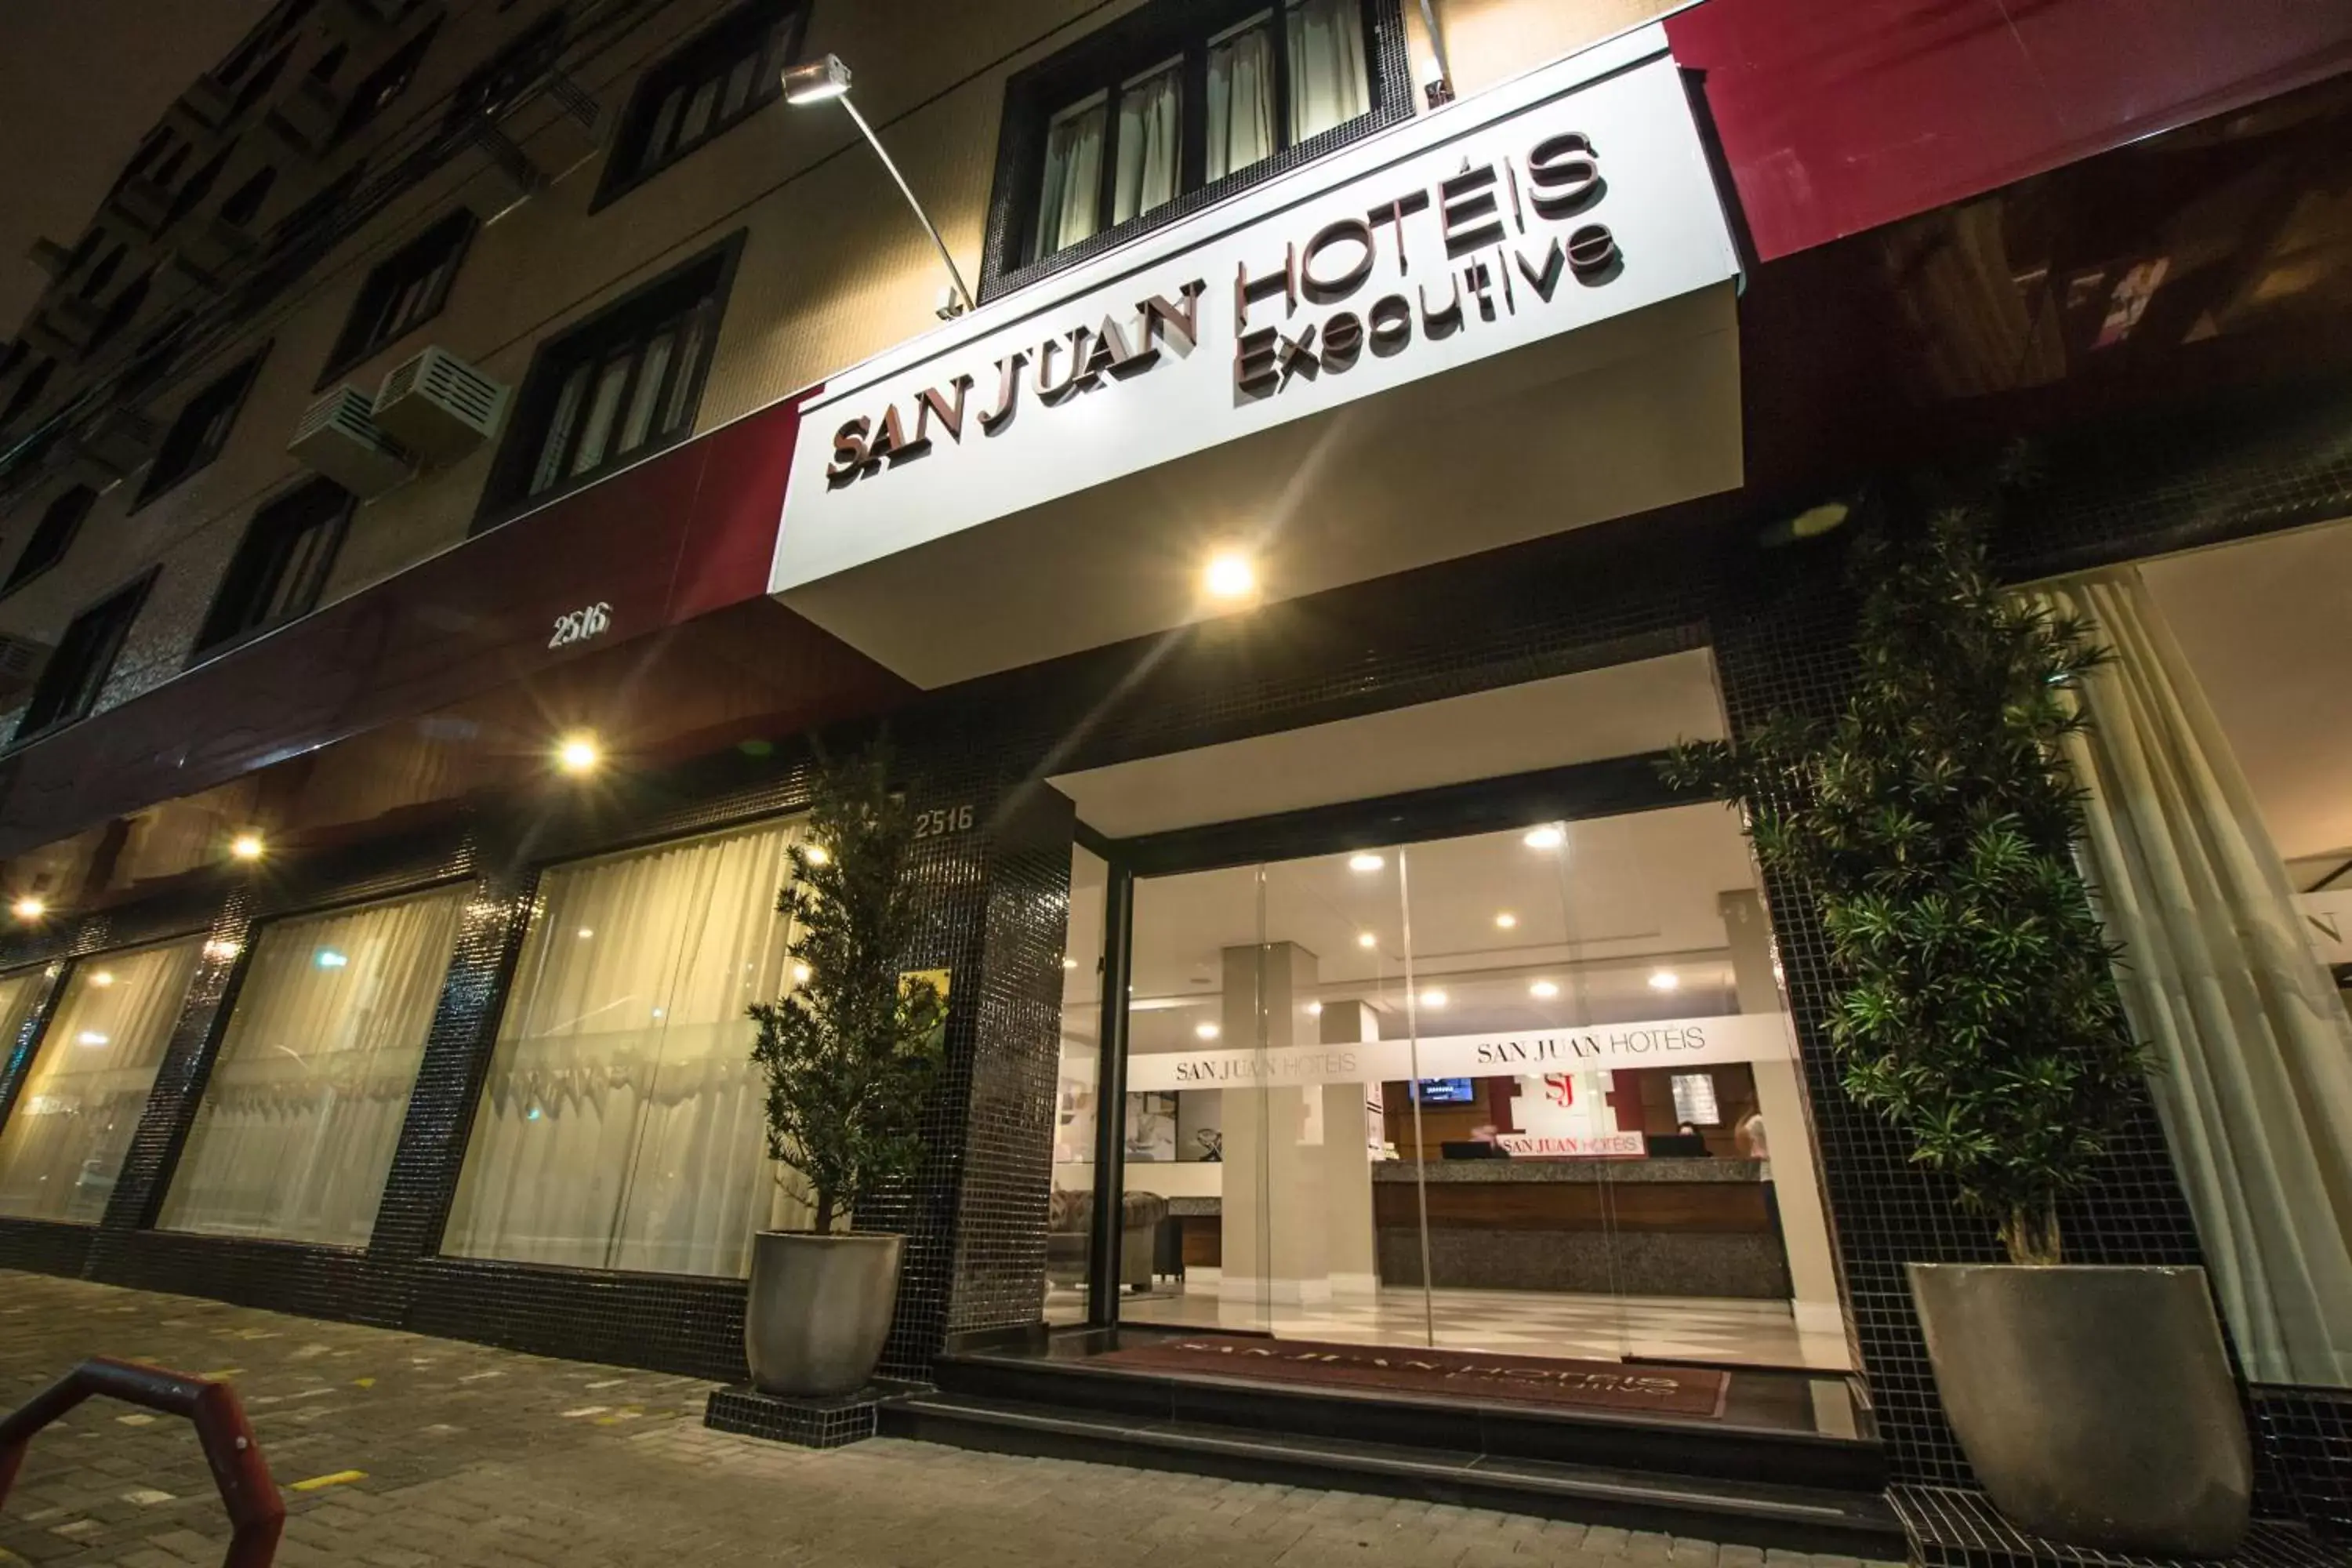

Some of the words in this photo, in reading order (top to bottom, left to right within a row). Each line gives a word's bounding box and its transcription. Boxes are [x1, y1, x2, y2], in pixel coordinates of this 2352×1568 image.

[826, 374, 974, 492] SAN
[978, 278, 1207, 437] JUAN
[1235, 130, 1604, 328] HOTÉIS
[548, 601, 612, 649] 2516
[915, 805, 973, 838] 2516
[1478, 1041, 1526, 1063] SAN
[1534, 1034, 1601, 1061] JUAN
[1176, 1062, 1216, 1081] SAN
[1220, 1058, 1276, 1080] JUAN
[1544, 1072, 1574, 1108] SJ
[1504, 1138, 1533, 1153] SAN
[1537, 1137, 1578, 1153] JUAN
